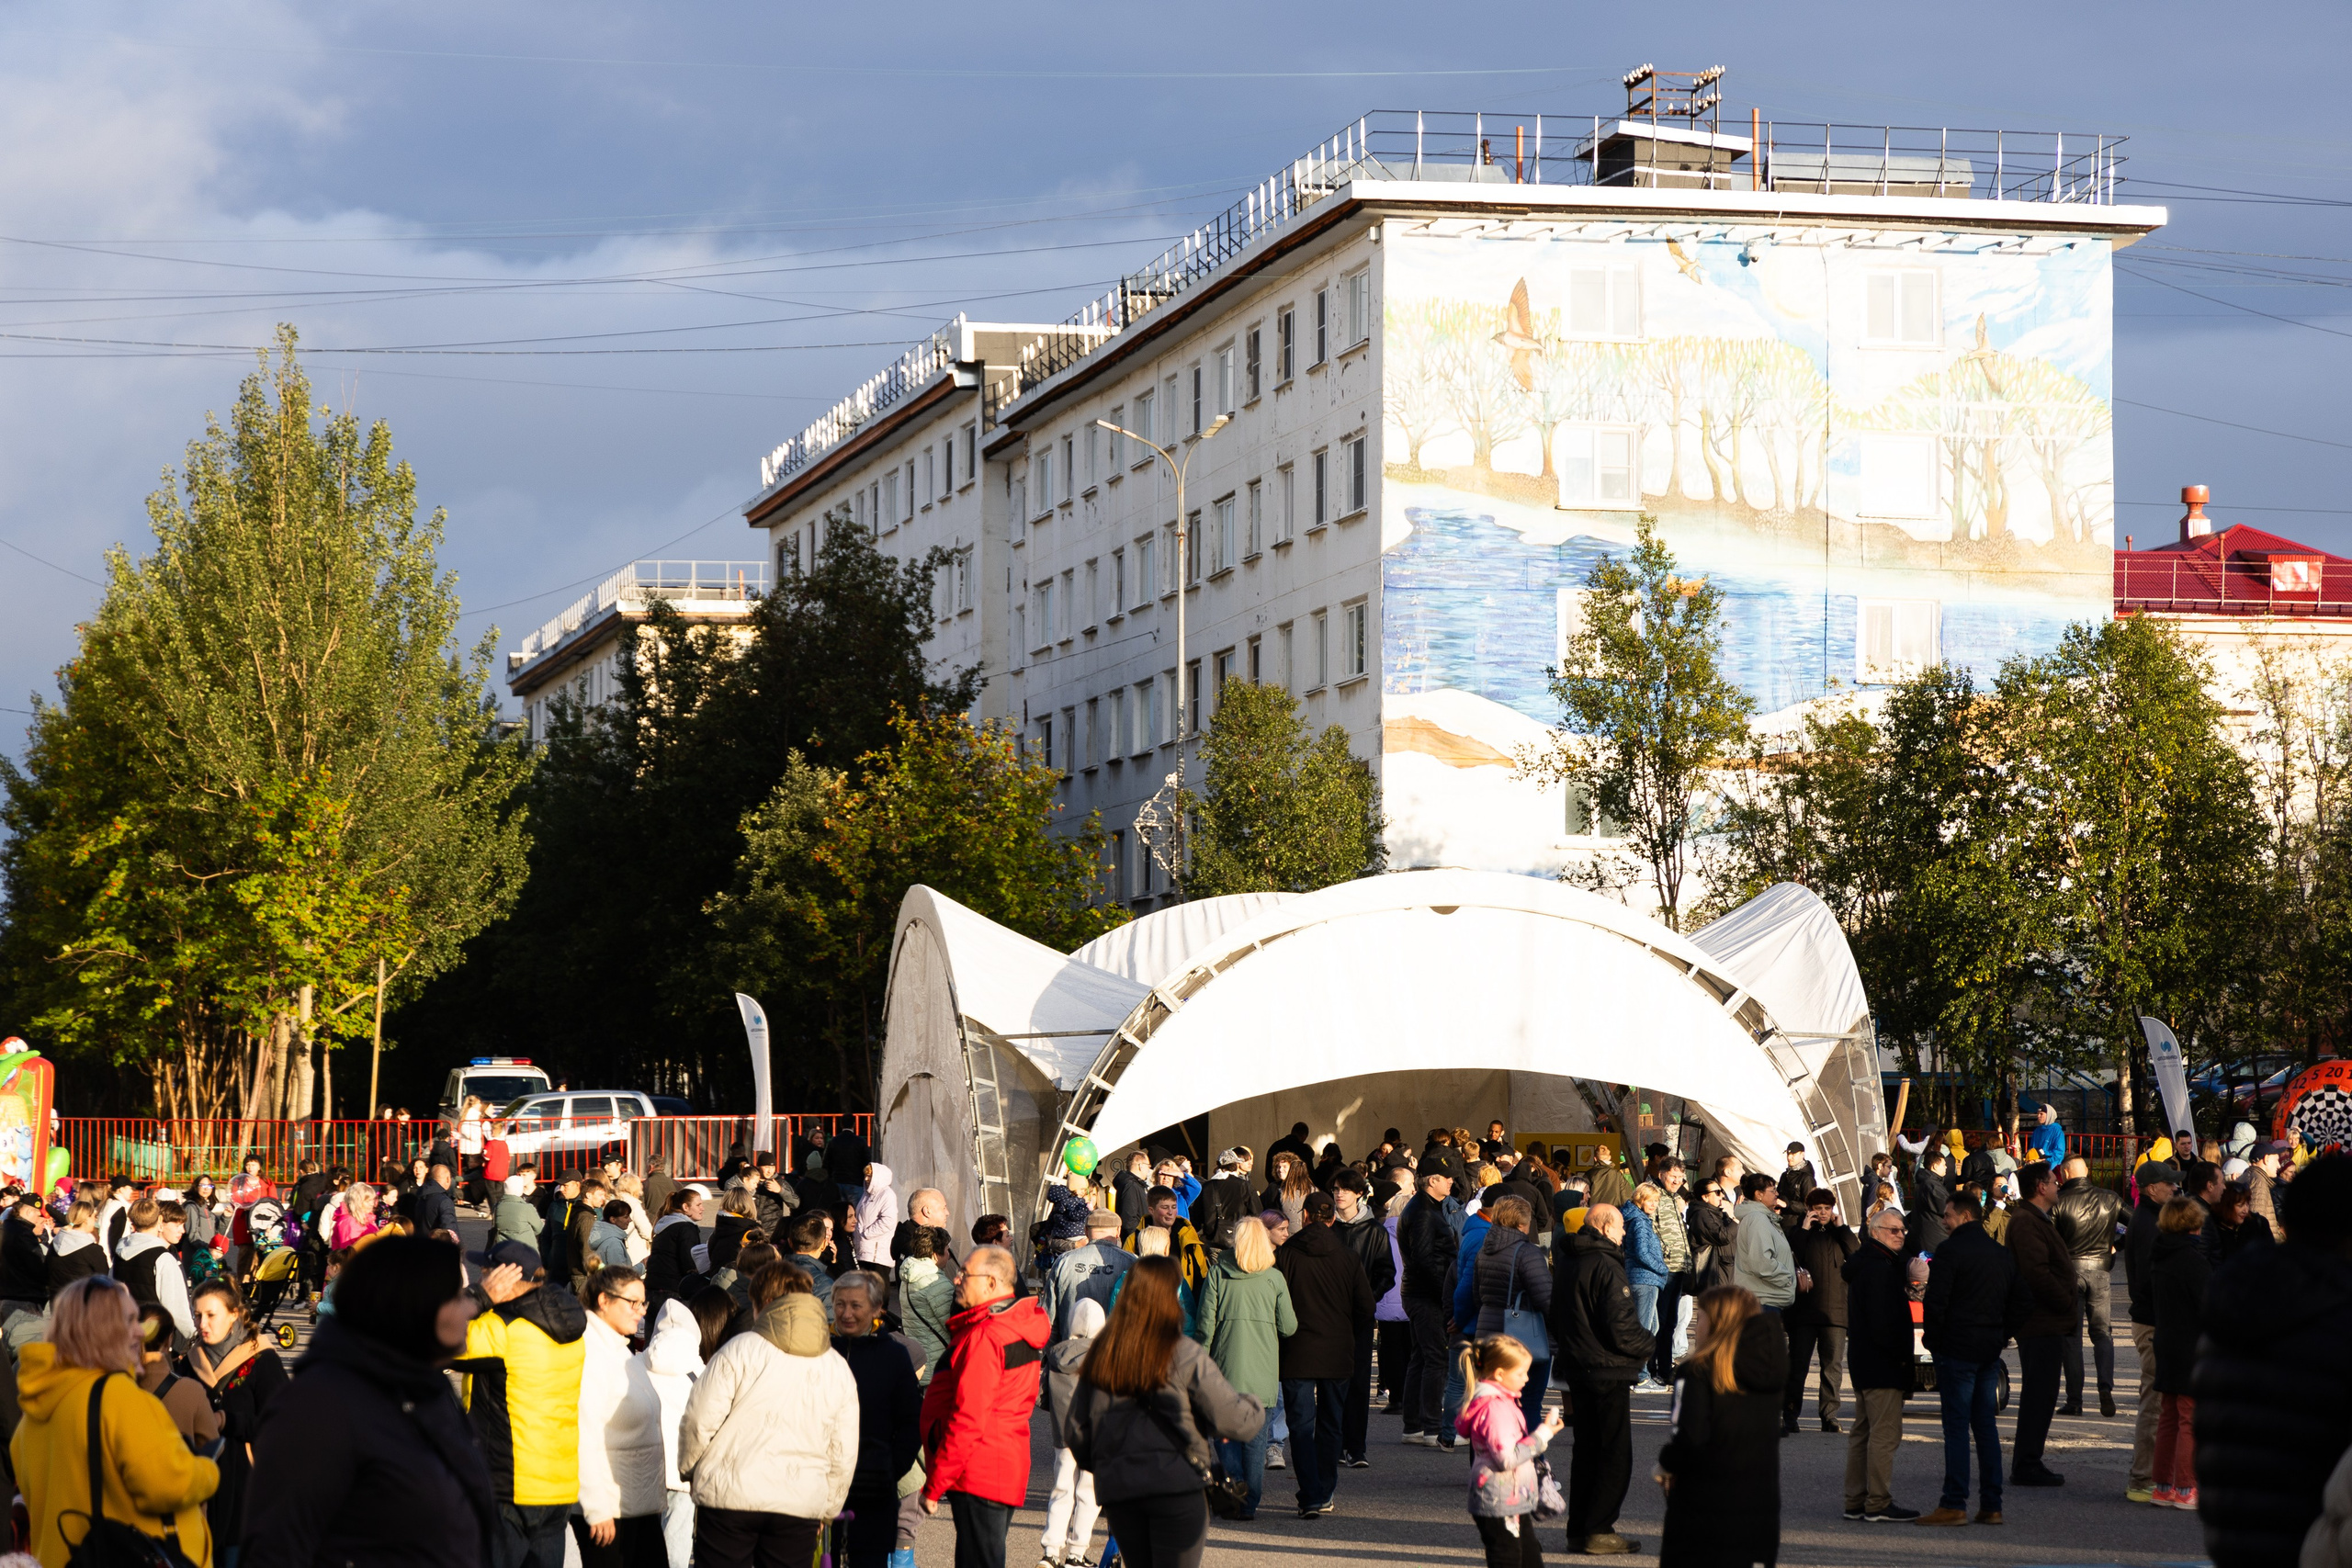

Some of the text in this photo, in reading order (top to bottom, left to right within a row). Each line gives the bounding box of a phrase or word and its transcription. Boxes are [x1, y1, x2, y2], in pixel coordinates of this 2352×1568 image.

[2312, 1069, 2320, 1079] 5
[2325, 1066, 2344, 1077] 20
[2292, 1077, 2307, 1089] 12
[2283, 1092, 2290, 1103] 9
[1074, 1262, 1114, 1275] S&C
